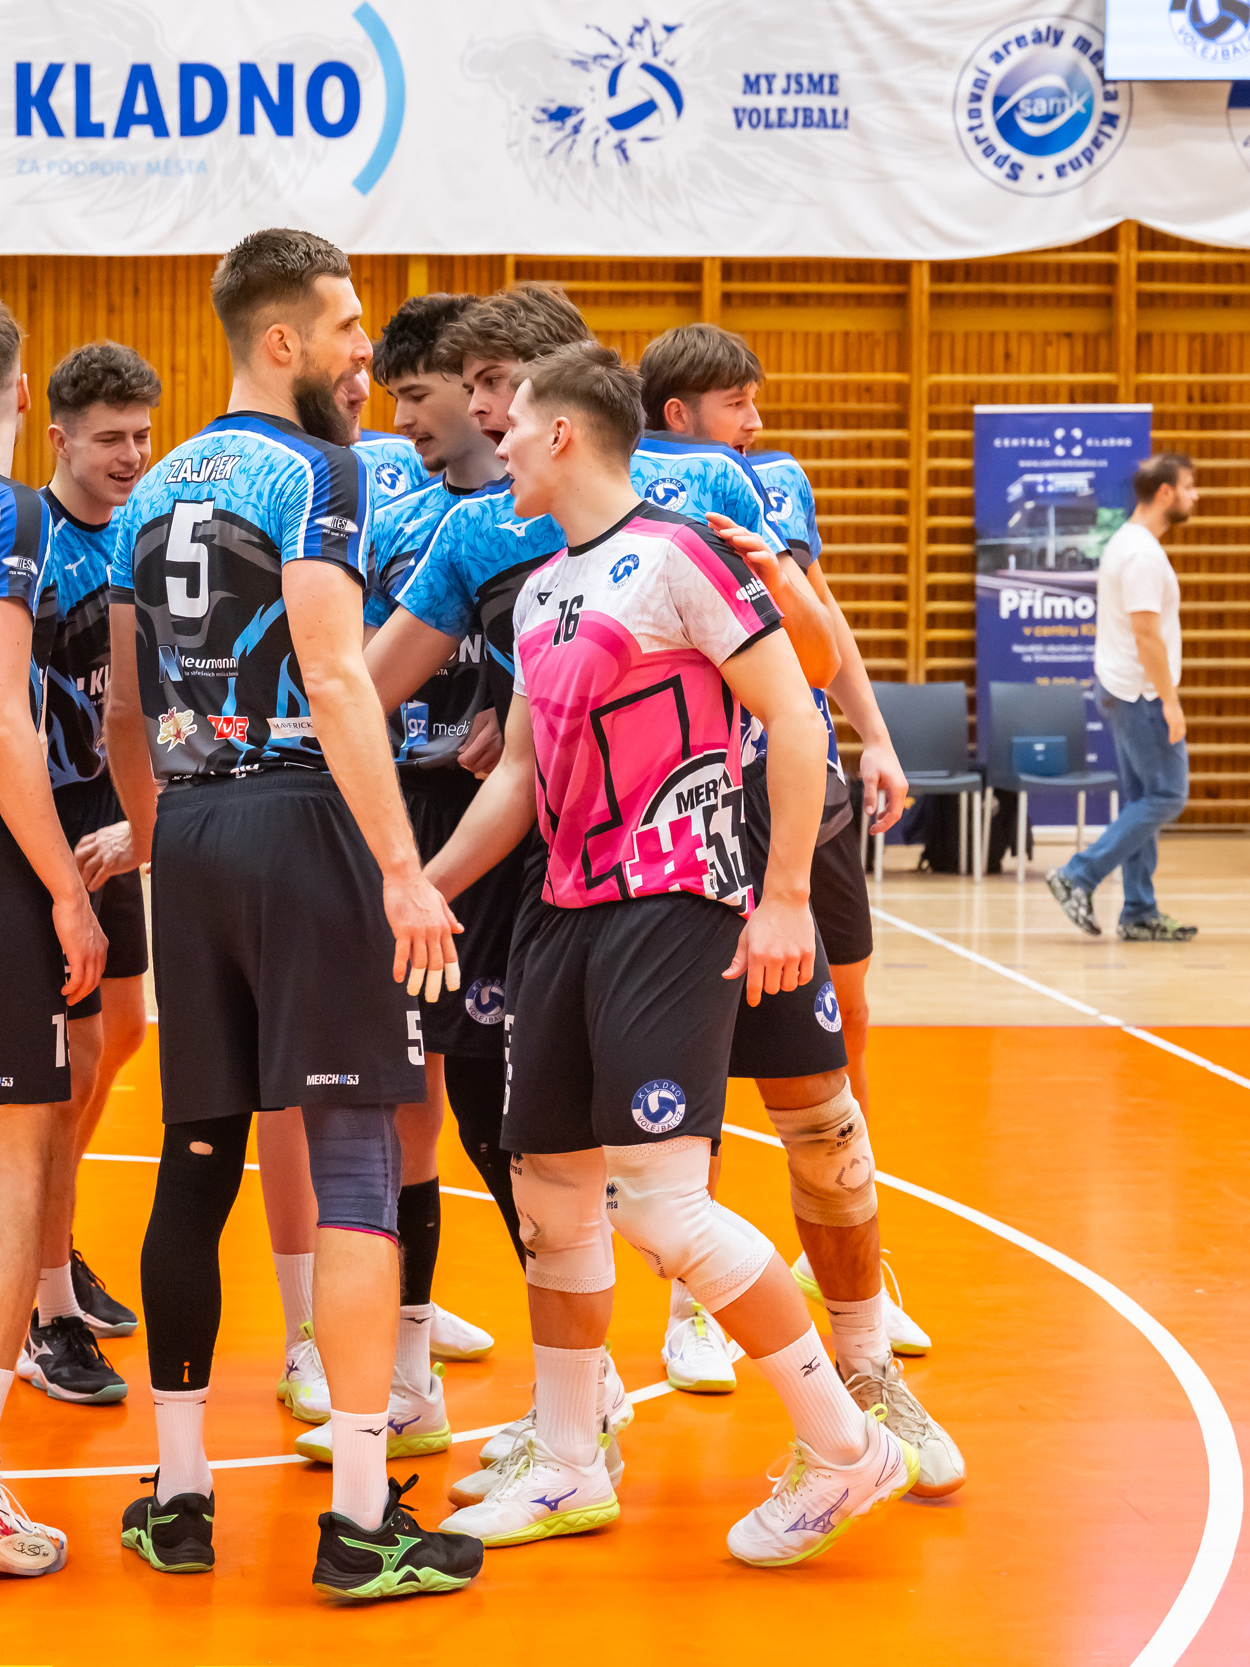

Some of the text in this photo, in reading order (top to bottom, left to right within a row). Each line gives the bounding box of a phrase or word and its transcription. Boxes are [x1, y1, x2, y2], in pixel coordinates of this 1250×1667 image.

[742, 72, 839, 95] MY JSME
[14, 60, 361, 138] KLADNO
[733, 106, 849, 130] VOLEJBAL!
[15, 159, 41, 176] ZA
[47, 160, 138, 177] PODPORY
[165, 500, 215, 618] 5
[551, 594, 585, 648] 16
[407, 718, 471, 738] gz medi
[406, 1010, 426, 1066] 5
[306, 1074, 360, 1087] MERCH#53
[637, 1081, 682, 1099] KLADNO
